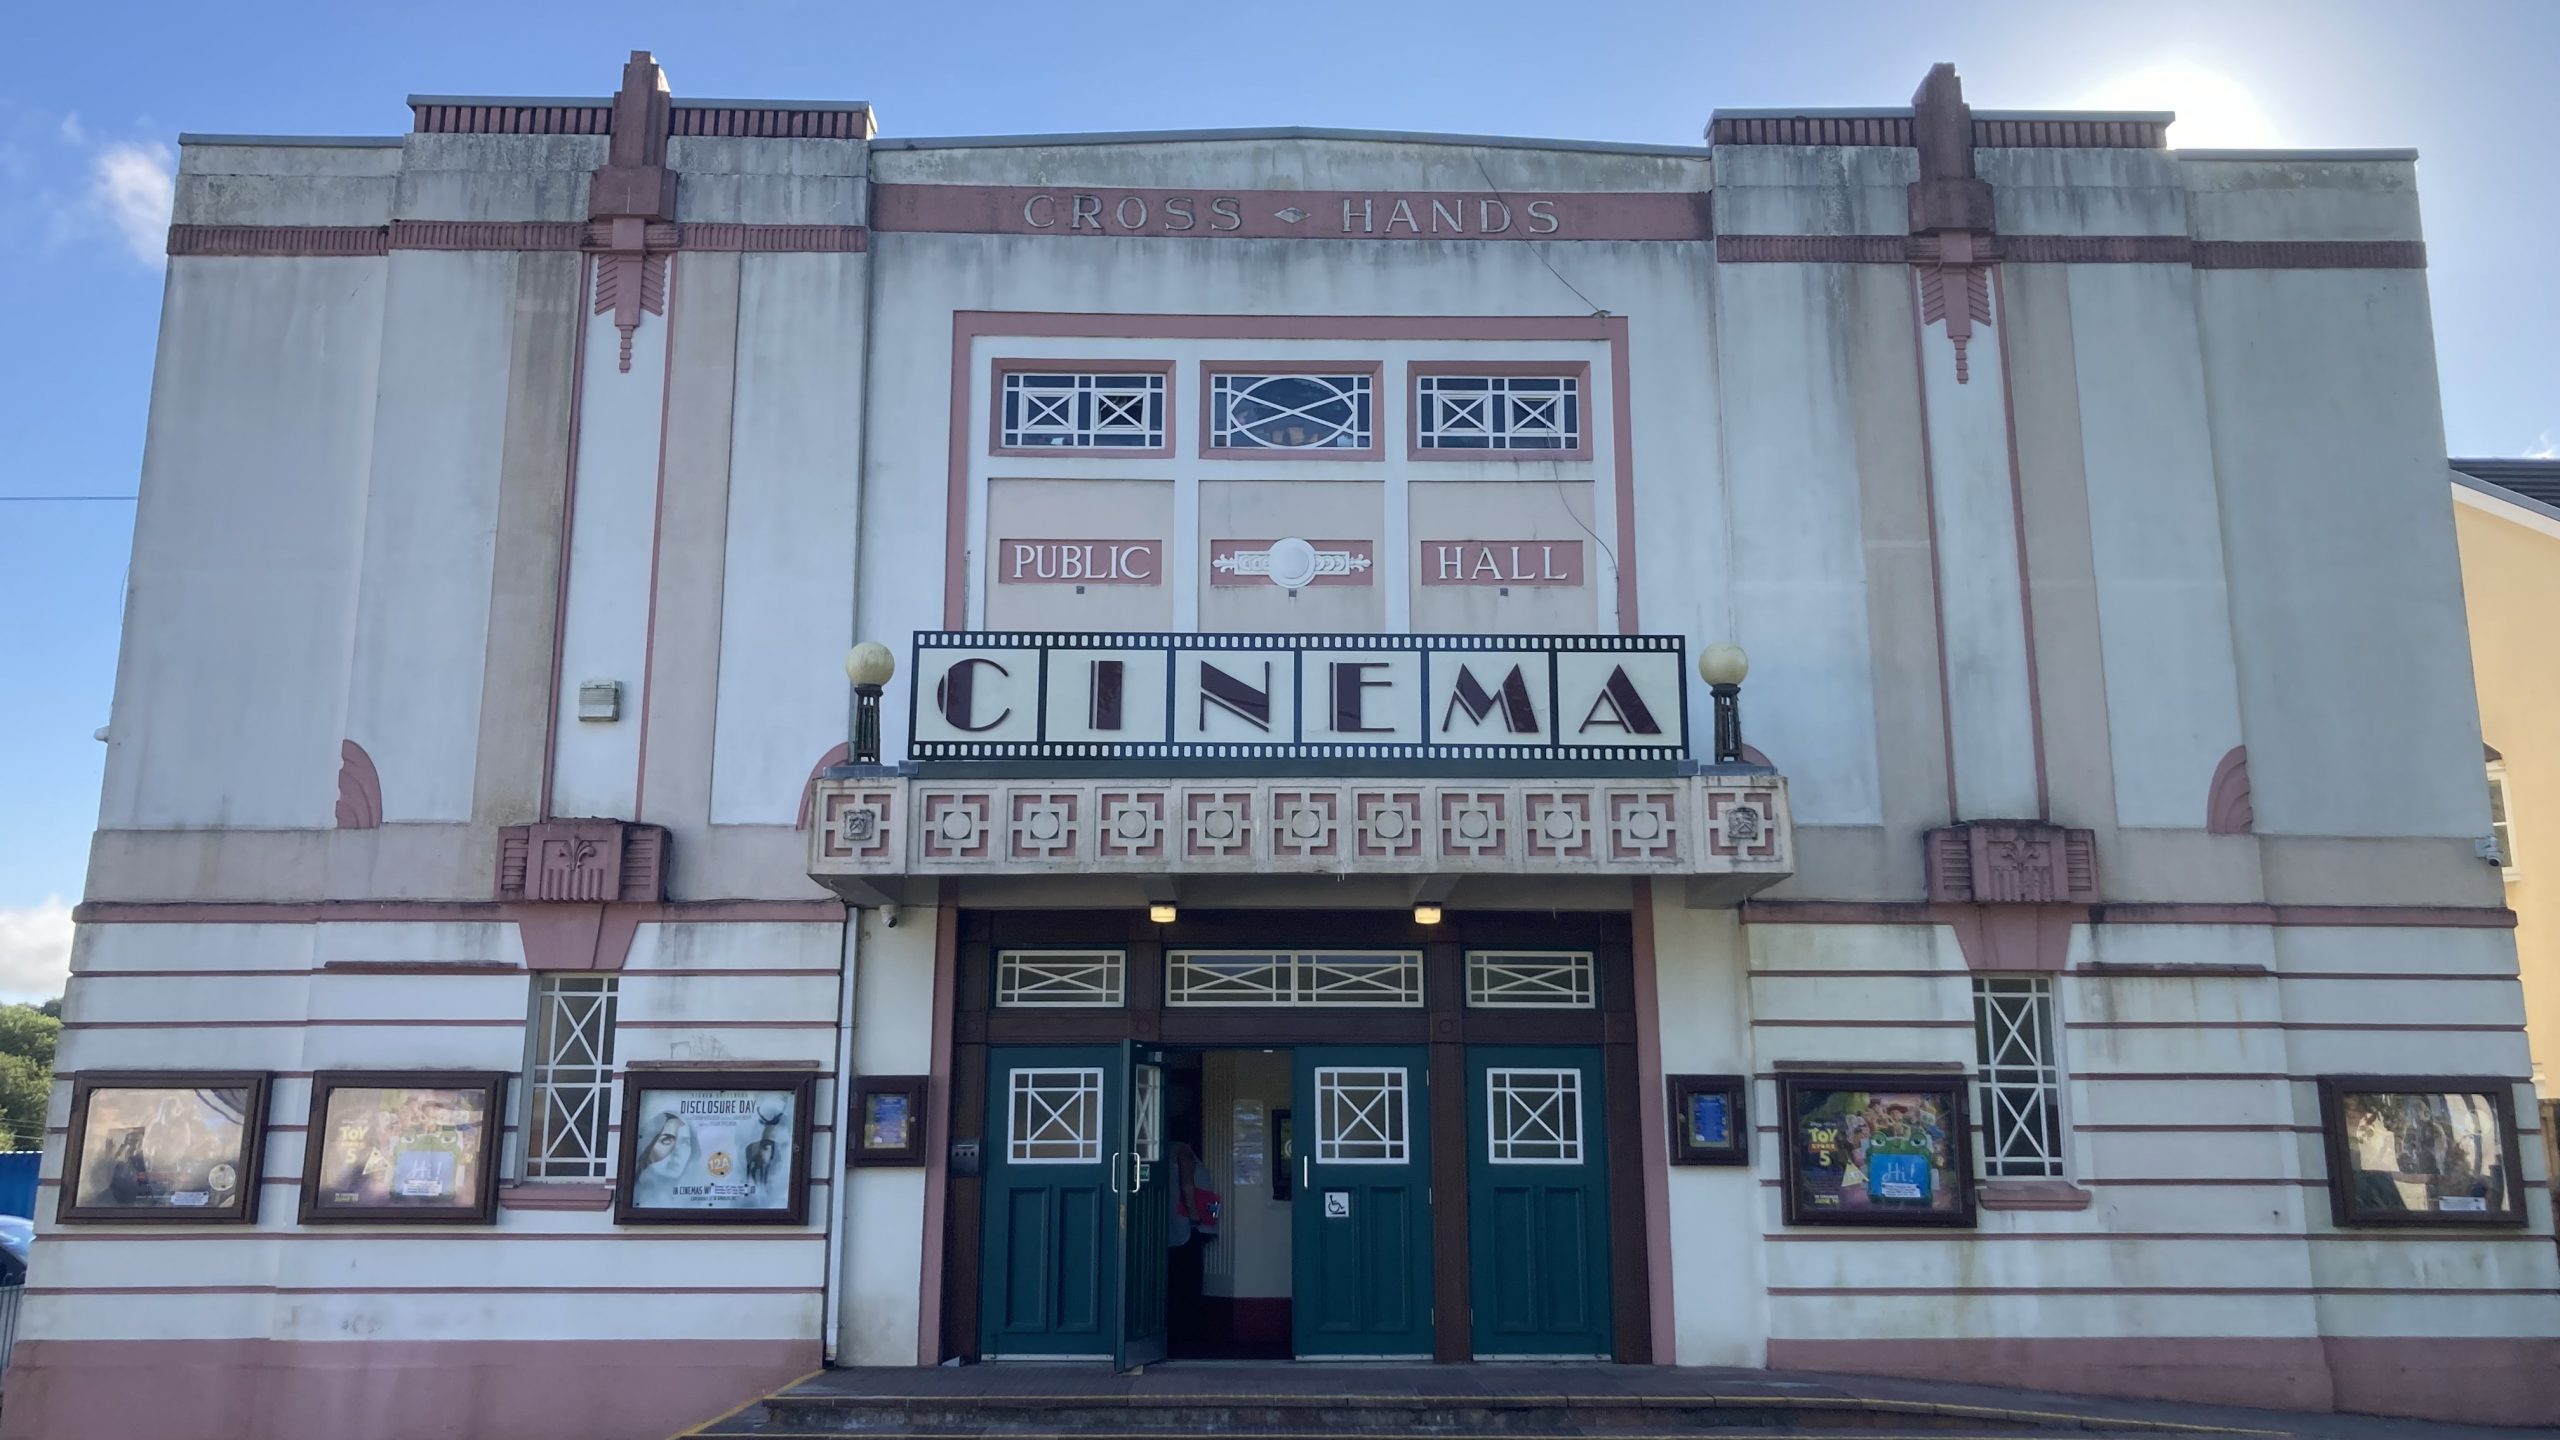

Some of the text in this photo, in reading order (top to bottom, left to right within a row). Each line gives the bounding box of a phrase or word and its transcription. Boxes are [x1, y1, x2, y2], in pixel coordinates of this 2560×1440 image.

[1023, 194, 1561, 234] CROSS HANDS
[1013, 544, 1568, 580] PUBLIC HALL
[936, 657, 1662, 735] CINEMA
[681, 1100, 756, 1114] DISCLOSURE DAY
[339, 1126, 368, 1140] TOY
[1808, 1128, 1838, 1142] TOY
[346, 1149, 356, 1163] 5
[1819, 1151, 1831, 1165] 5
[407, 1159, 443, 1180] Hi!
[709, 1158, 729, 1169] 12A
[1882, 1163, 1915, 1182] Hi!
[680, 1186, 702, 1195] CINEMAS
